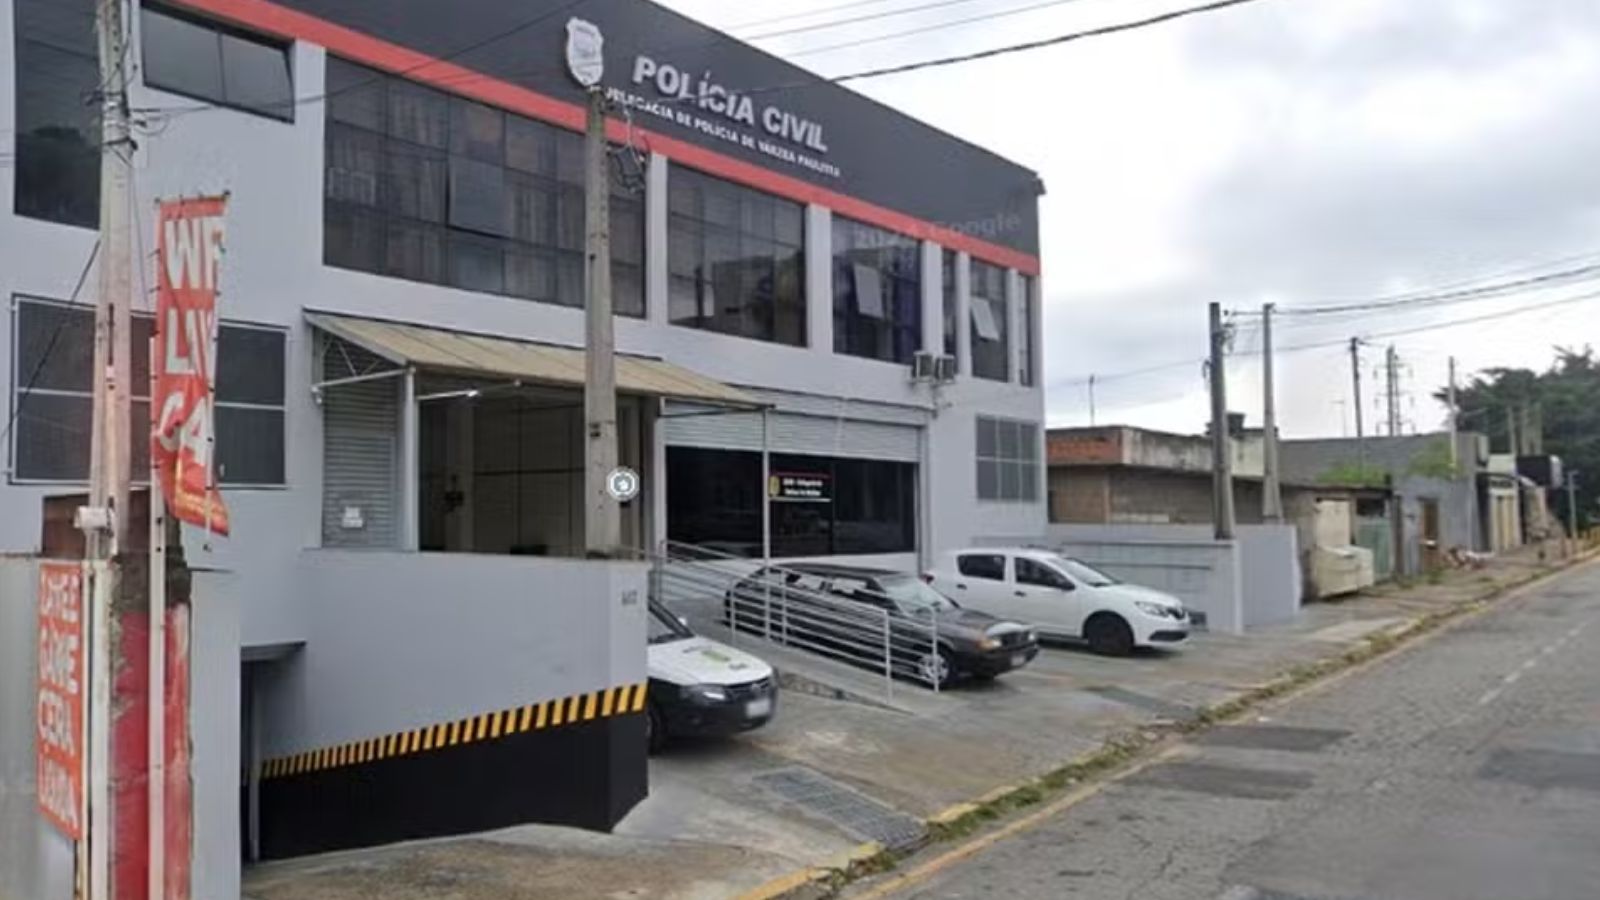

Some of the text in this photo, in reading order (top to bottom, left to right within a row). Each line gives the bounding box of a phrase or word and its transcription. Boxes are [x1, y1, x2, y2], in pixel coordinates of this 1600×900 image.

[632, 56, 828, 152] POLÍCIA CIVIL
[676, 111, 692, 127] DE
[741, 133, 756, 149] DE
